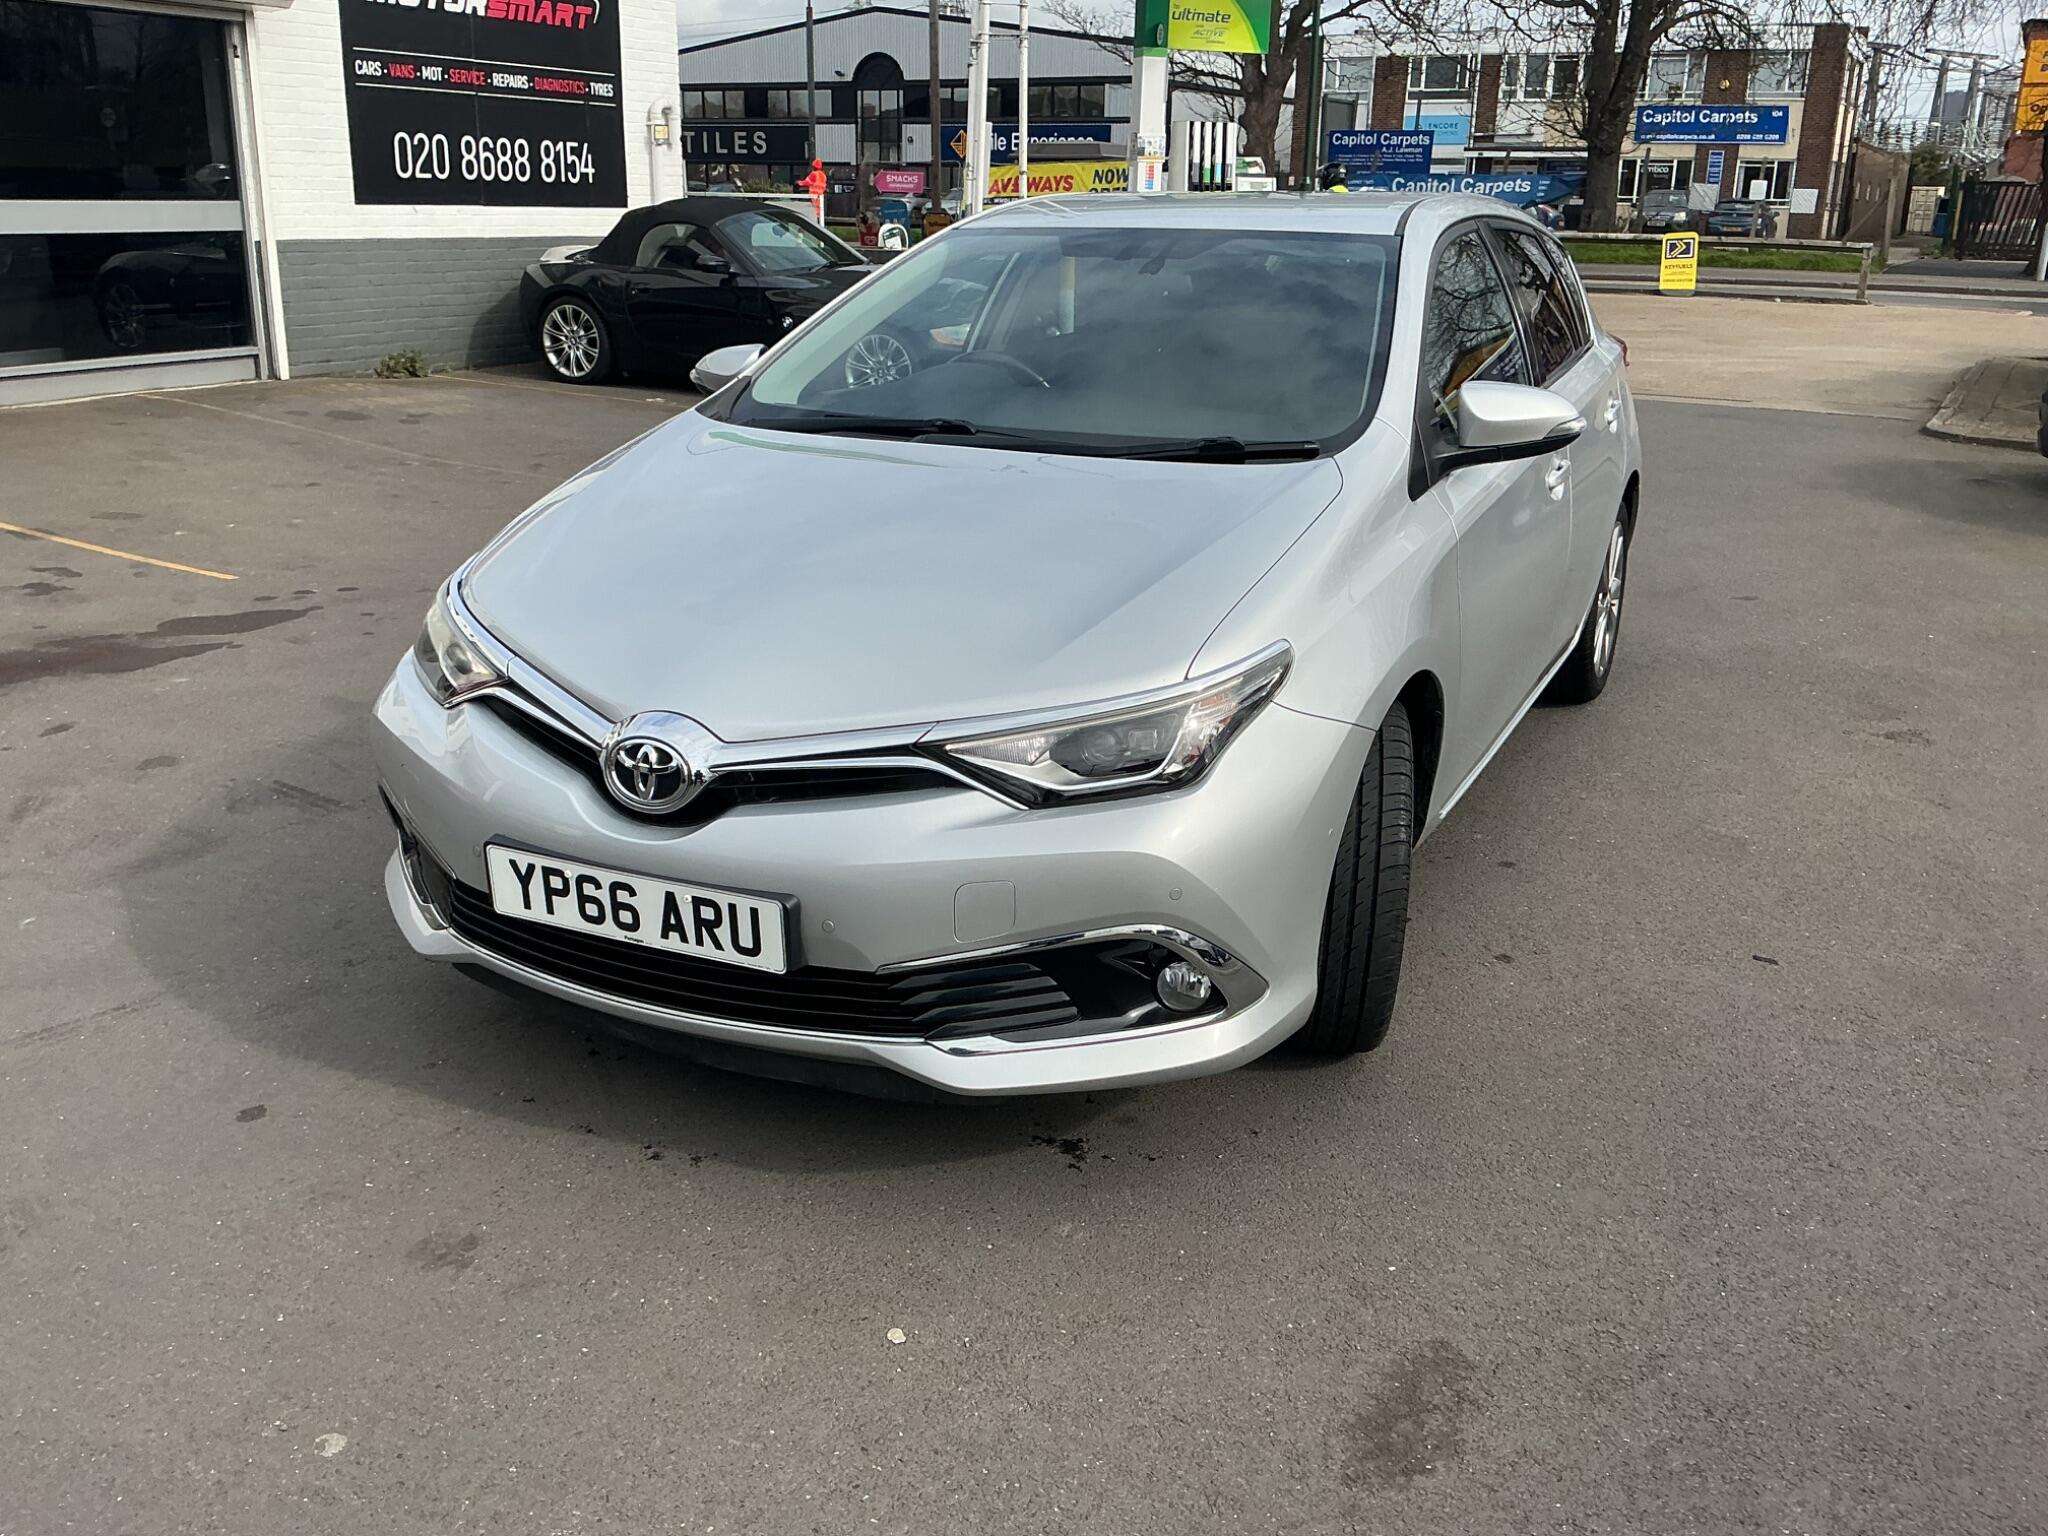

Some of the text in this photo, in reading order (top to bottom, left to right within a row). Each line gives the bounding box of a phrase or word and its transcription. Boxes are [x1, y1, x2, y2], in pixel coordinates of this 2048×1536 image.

[1172, 8, 1231, 23] ultimate
[354, 59, 614, 97] CARS VANS MOT SERVICE REPAIRS DIAGNOSTICS TYRES
[1642, 110, 1695, 126] Capitol
[1699, 110, 1758, 125] Carpets
[683, 131, 767, 154] TILES
[1332, 133, 1431, 147] Capitol Carpets
[393, 131, 595, 184] 020 8688 8154
[886, 174, 918, 183] SMACKS
[1092, 168, 1129, 185] NOW
[1460, 177, 1532, 195] Carpets
[508, 858, 761, 958] YP66 ARU
